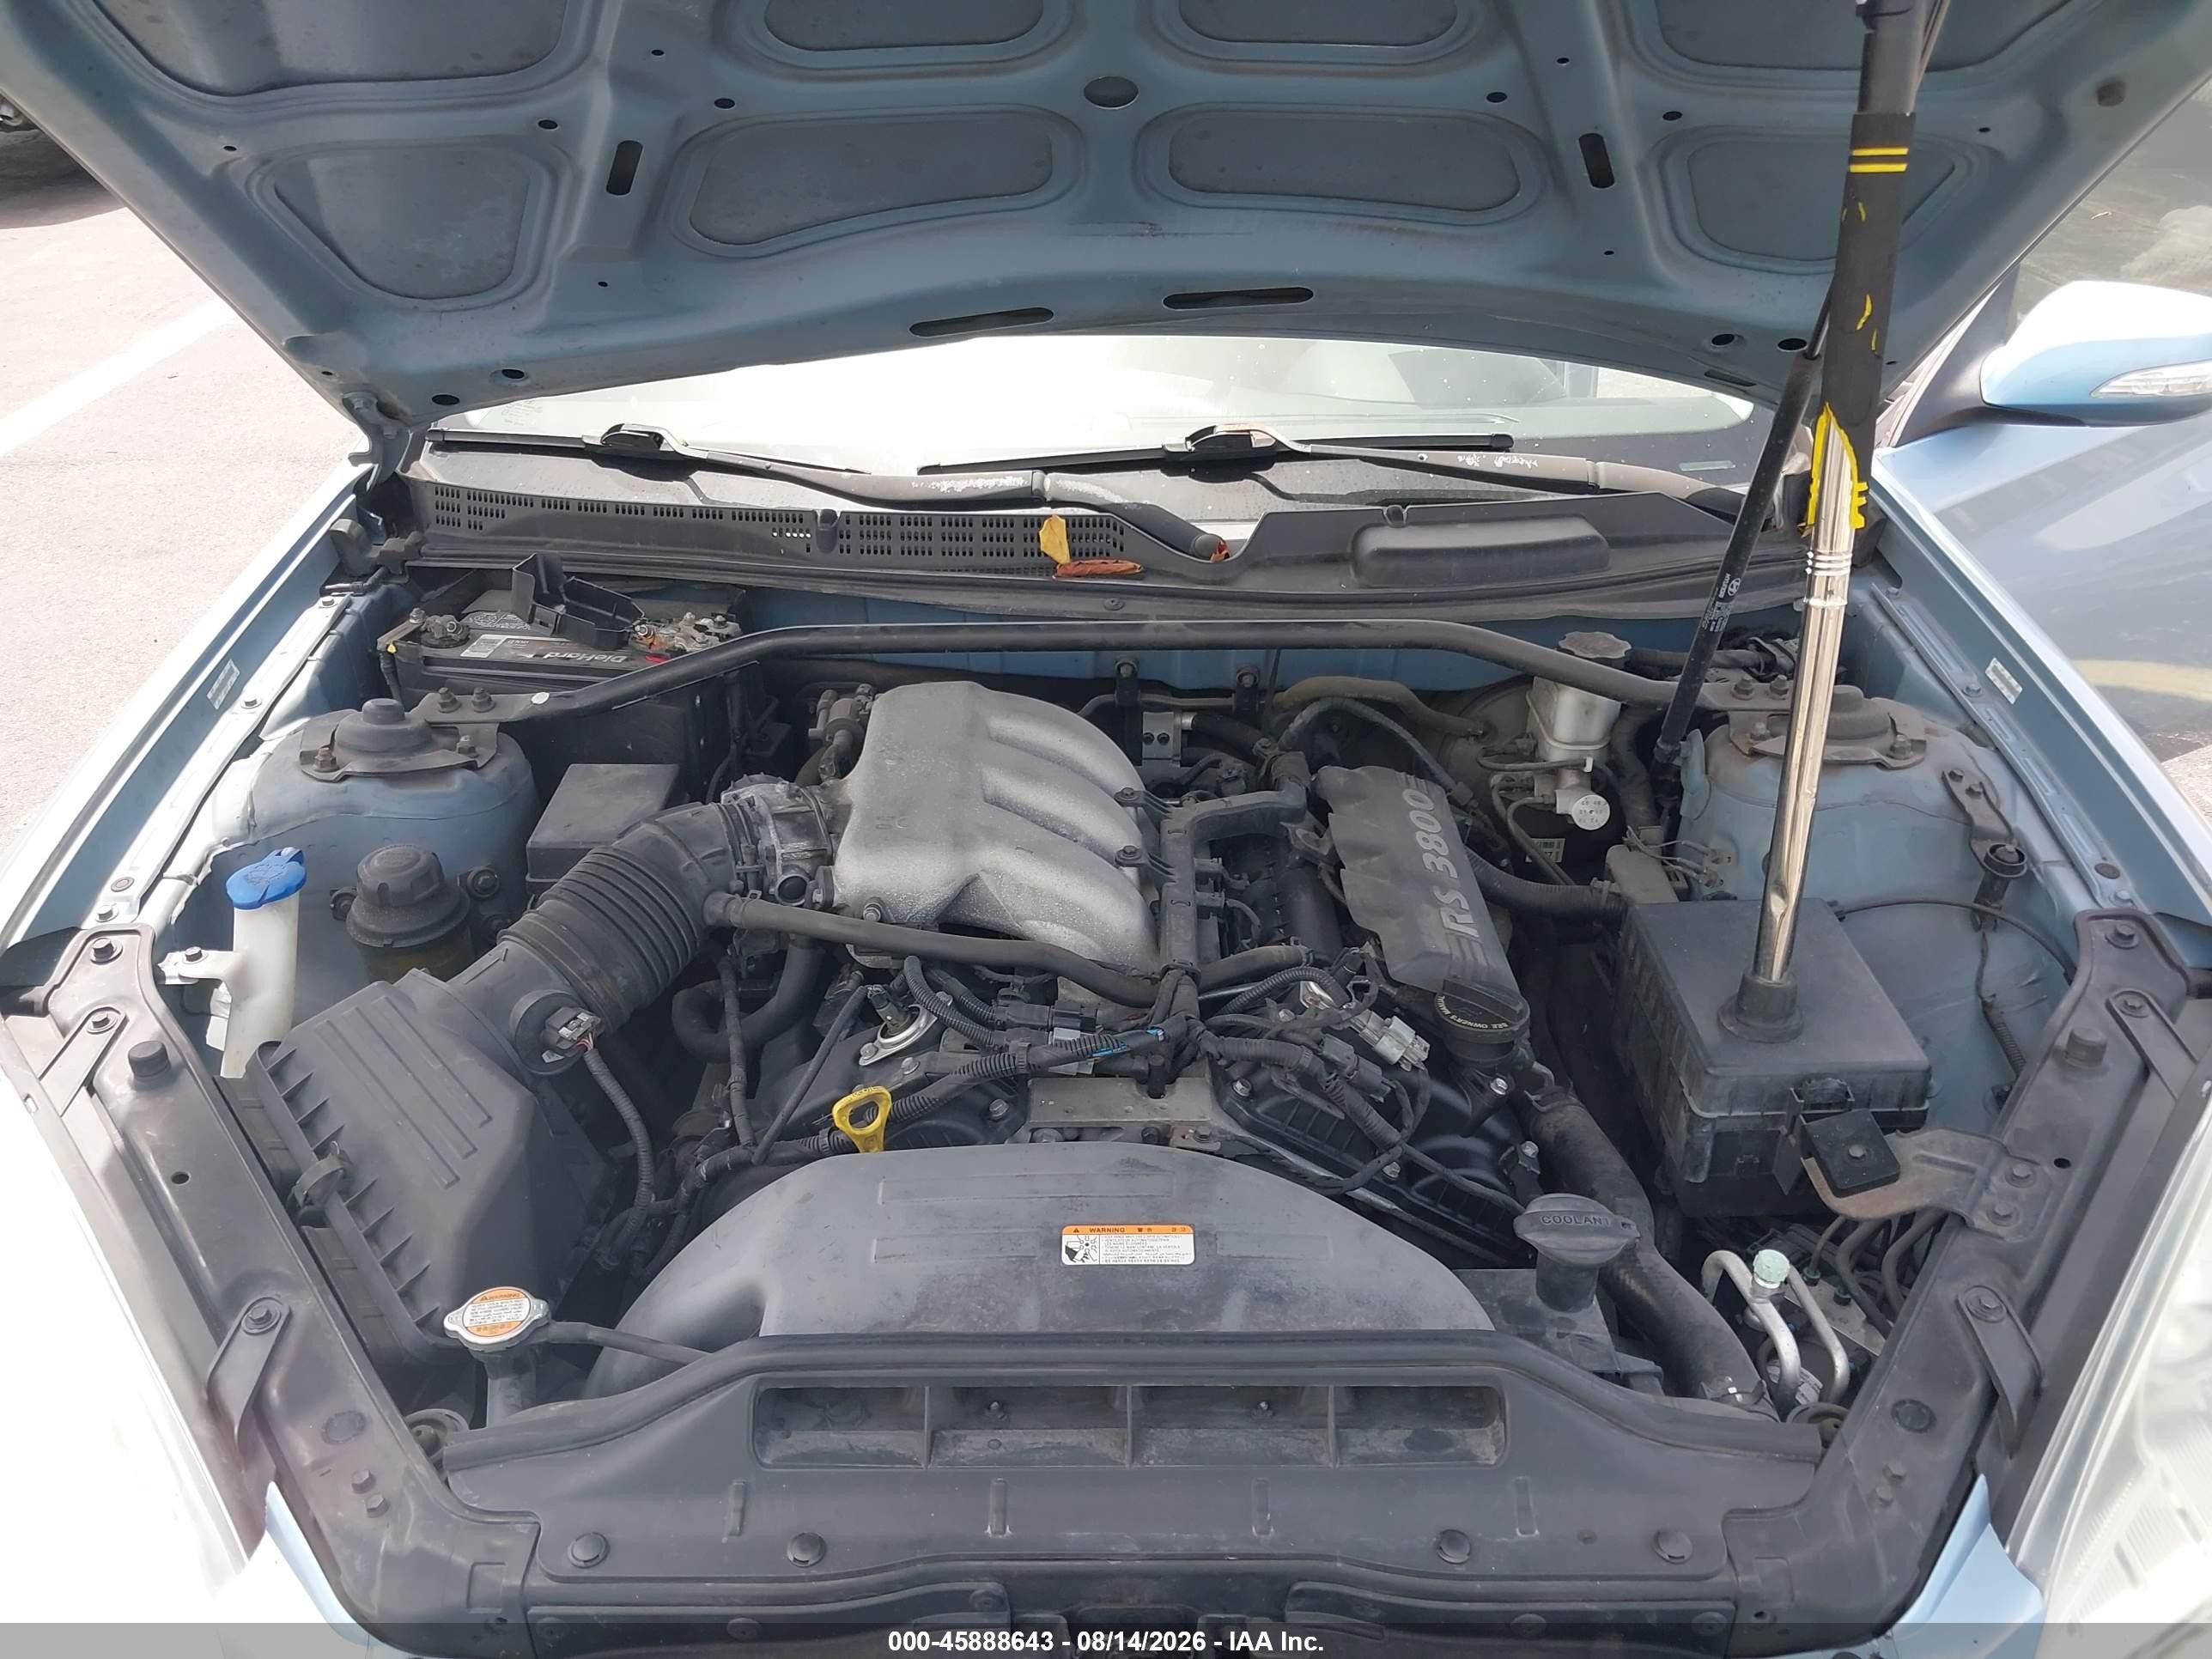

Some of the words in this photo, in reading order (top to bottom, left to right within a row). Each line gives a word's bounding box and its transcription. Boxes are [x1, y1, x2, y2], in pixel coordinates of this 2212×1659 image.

[543, 651, 629, 663] DieHard
[1402, 788, 1458, 880] 3800
[1432, 886, 1480, 939] RS
[1540, 1215, 1611, 1226] COOLANT
